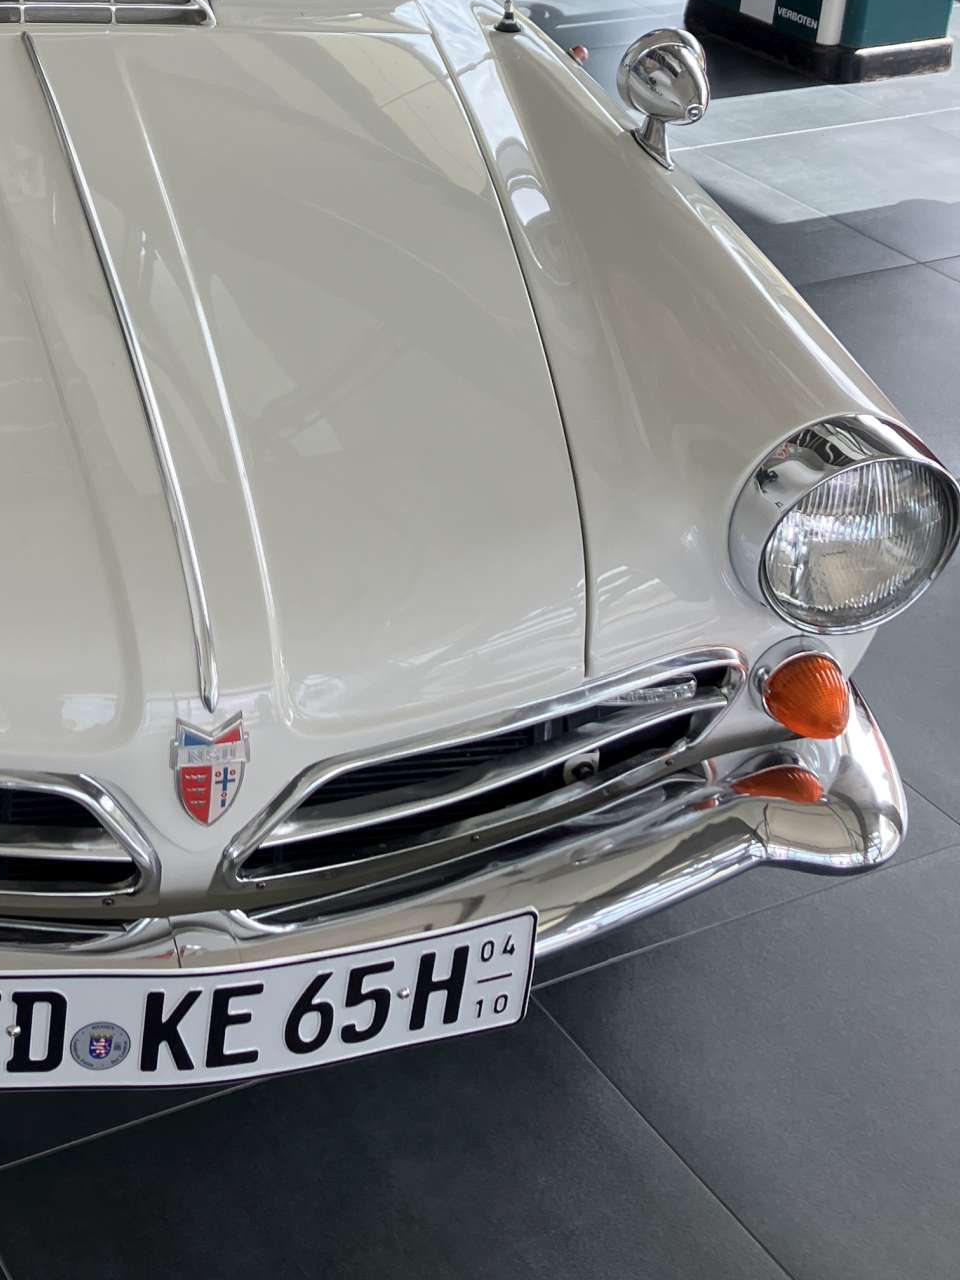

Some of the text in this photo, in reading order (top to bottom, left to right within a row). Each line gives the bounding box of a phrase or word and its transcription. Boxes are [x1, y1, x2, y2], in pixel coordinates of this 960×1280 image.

[777, 6, 818, 29] VERBOTEN
[480, 933, 516, 962] 04
[474, 993, 509, 1018] 10
[140, 982, 265, 1072] KE
